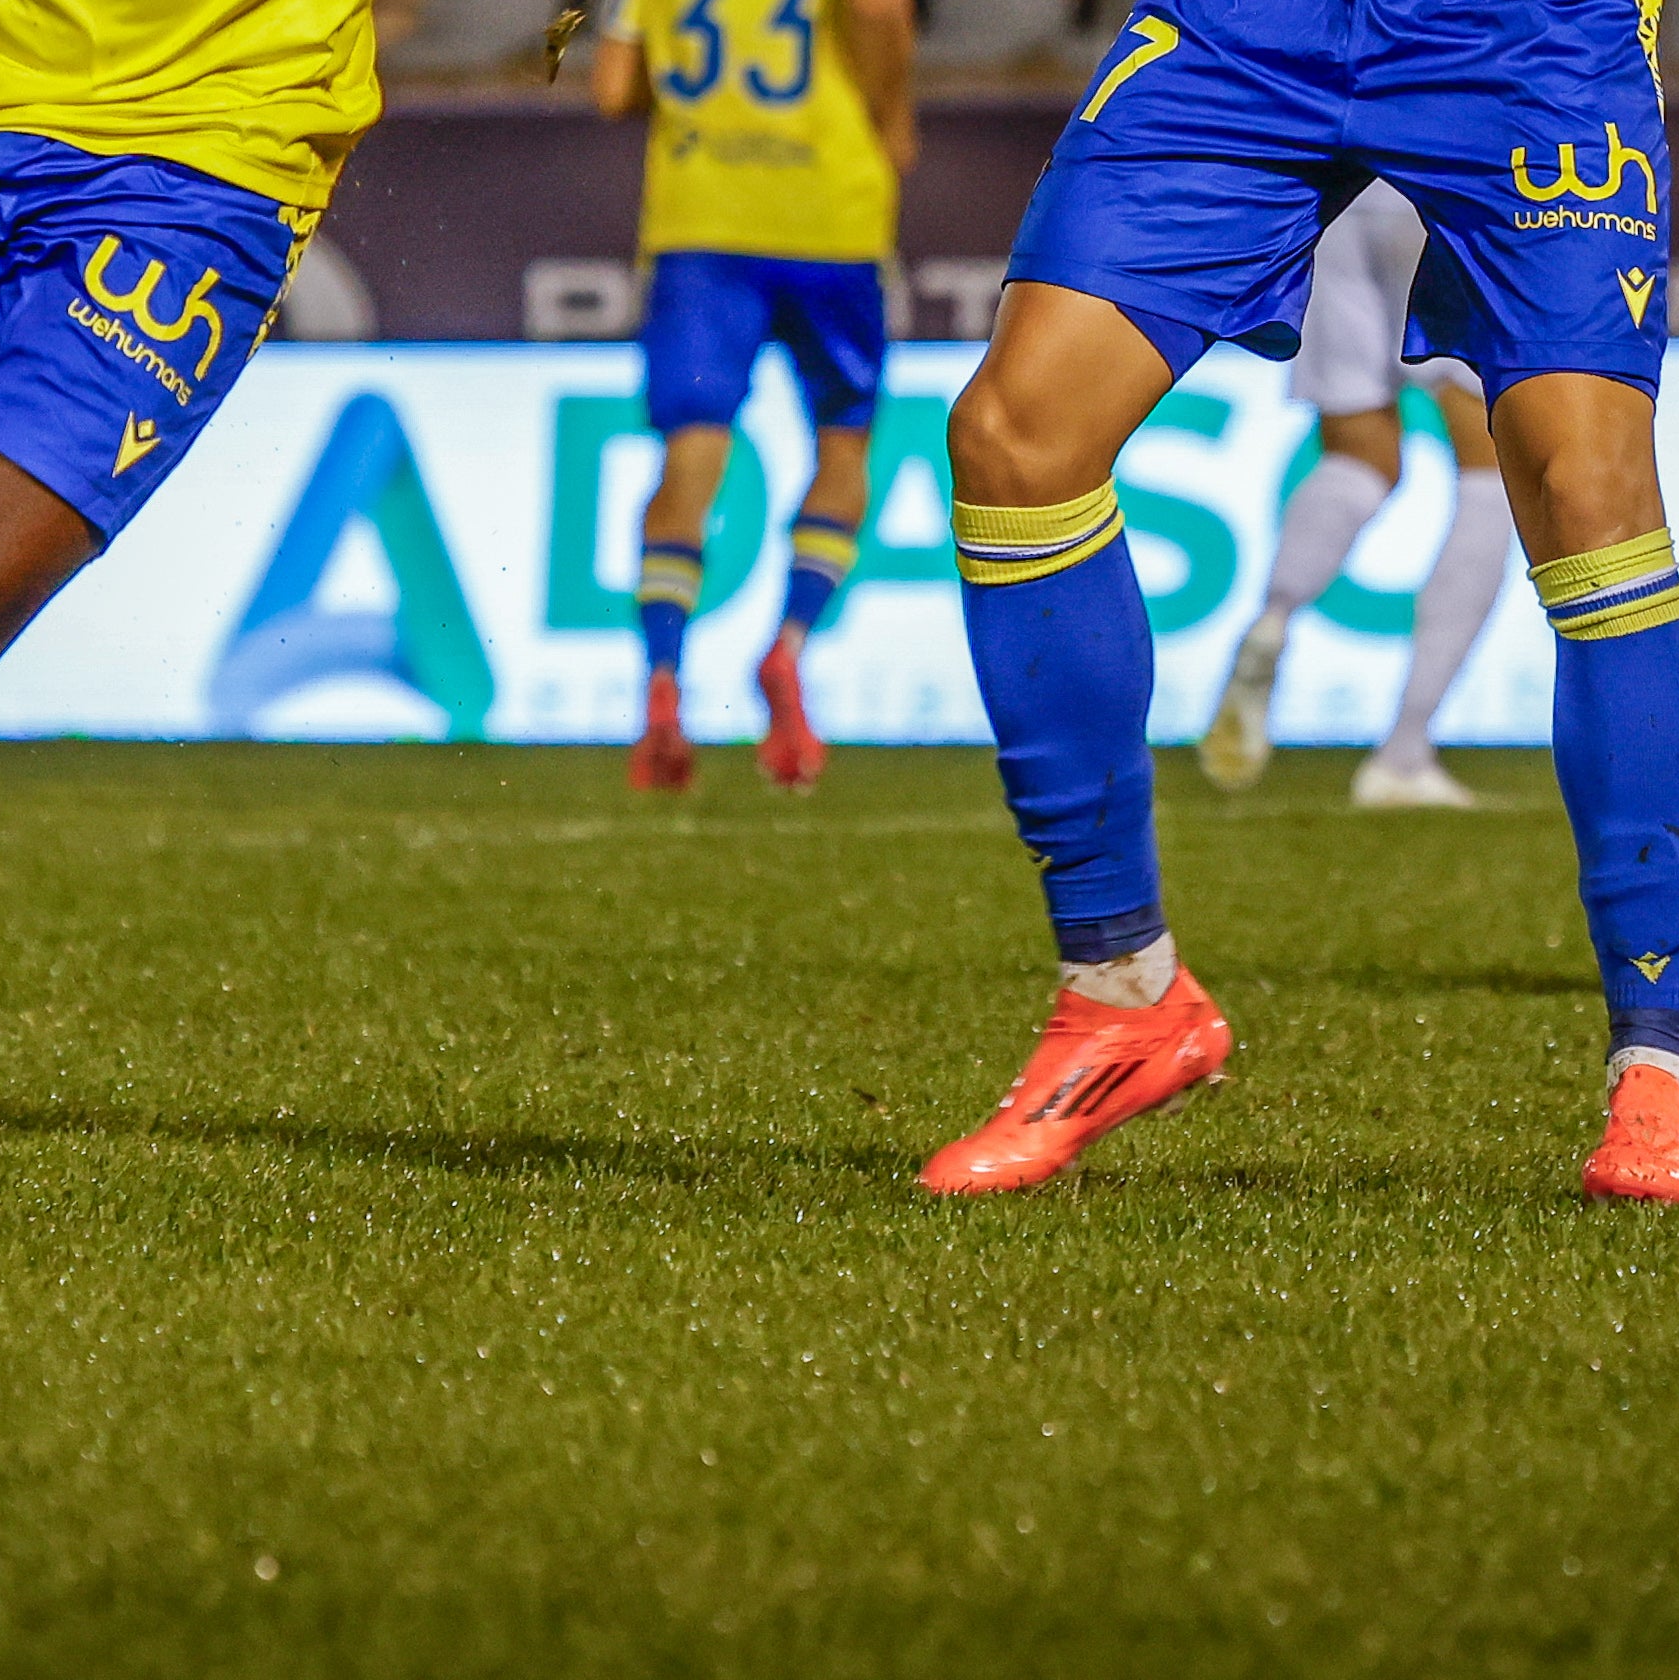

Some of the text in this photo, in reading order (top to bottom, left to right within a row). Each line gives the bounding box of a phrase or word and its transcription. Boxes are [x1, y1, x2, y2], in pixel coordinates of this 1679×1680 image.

[1080, 12, 1180, 123] 7
[1514, 205, 1657, 242] wehumans
[67, 296, 195, 407] wehumans
